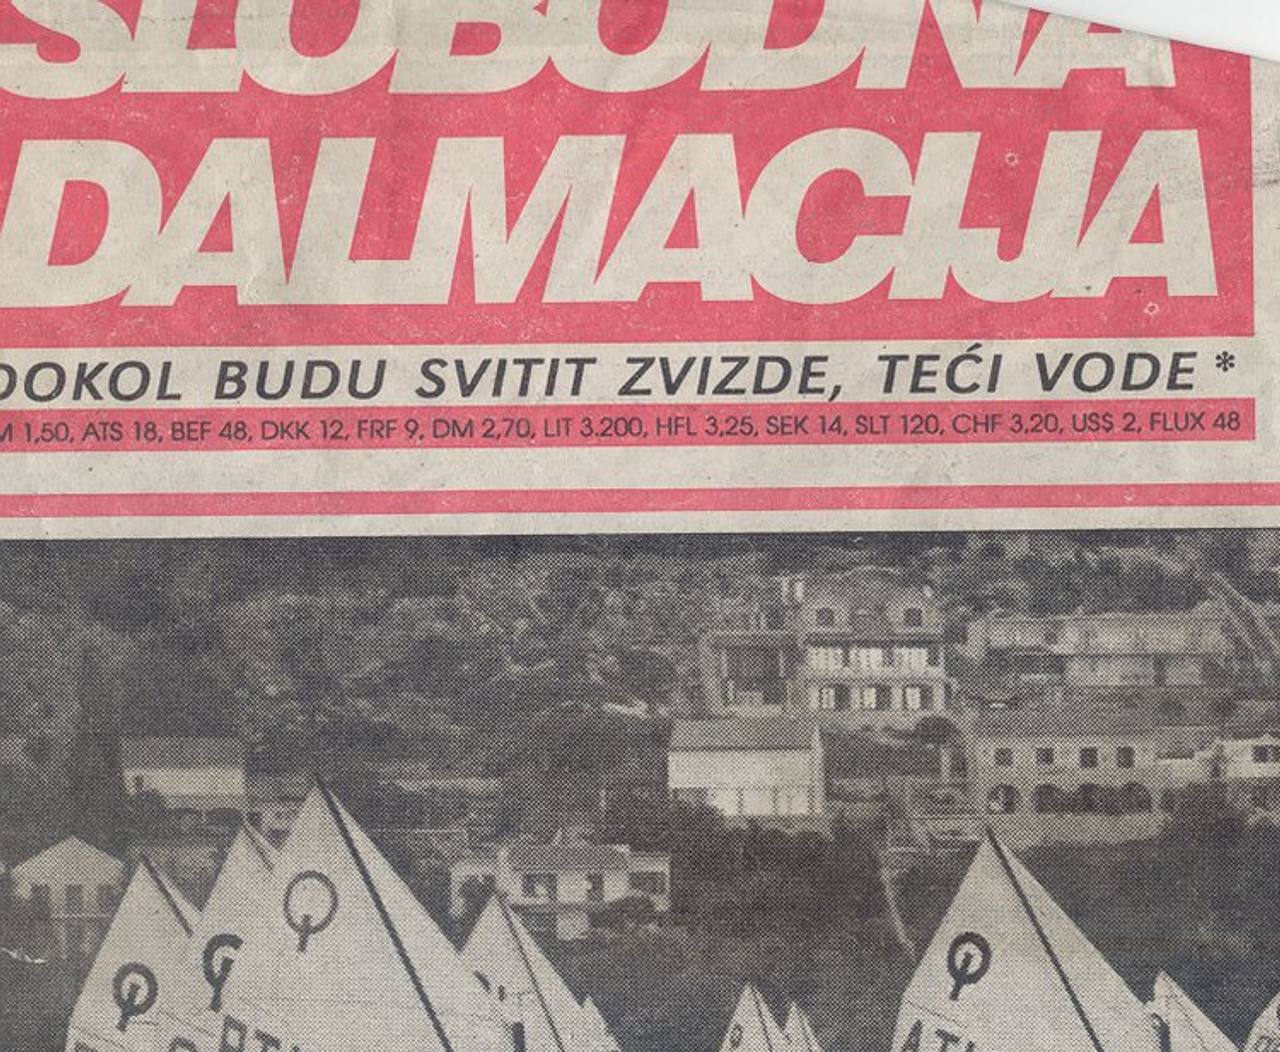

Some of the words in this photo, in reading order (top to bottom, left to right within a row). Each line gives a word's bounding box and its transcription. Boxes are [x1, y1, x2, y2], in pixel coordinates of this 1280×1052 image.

[0, 127, 1218, 308] DALMACIJA
[214, 359, 387, 400] BUDU
[415, 356, 597, 399] SVITIT
[617, 354, 842, 402] ZVIZDE,
[878, 343, 1003, 394] TEĆI
[1035, 351, 1198, 393] VODE
[25, 421, 74, 444] 1,50,
[82, 421, 122, 442] ATS
[134, 421, 163, 443] 18,
[171, 421, 211, 441] BEF
[219, 421, 252, 442] 48,
[261, 419, 311, 440] DKK
[320, 419, 350, 441] 12,
[357, 418, 397, 439] FRF
[405, 418, 424, 440] 9,
[432, 418, 474, 438] DM
[481, 417, 536, 440] 2,70,
[544, 416, 572, 437] LIT
[580, 416, 649, 438] 3.200,
[656, 416, 697, 436] HFL
[705, 415, 759, 438] 3,25,
[766, 414, 808, 435] SEK
[820, 414, 848, 436] 14,
[855, 413, 890, 434] SLT
[902, 413, 944, 436] 120,
[952, 412, 1003, 434] CHF
[1010, 411, 1063, 434] 3,20,
[1072, 410, 1114, 433] US$
[1122, 410, 1142, 434] 2,
[1150, 410, 1206, 432] FLUX
[1213, 409, 1241, 431] 48
